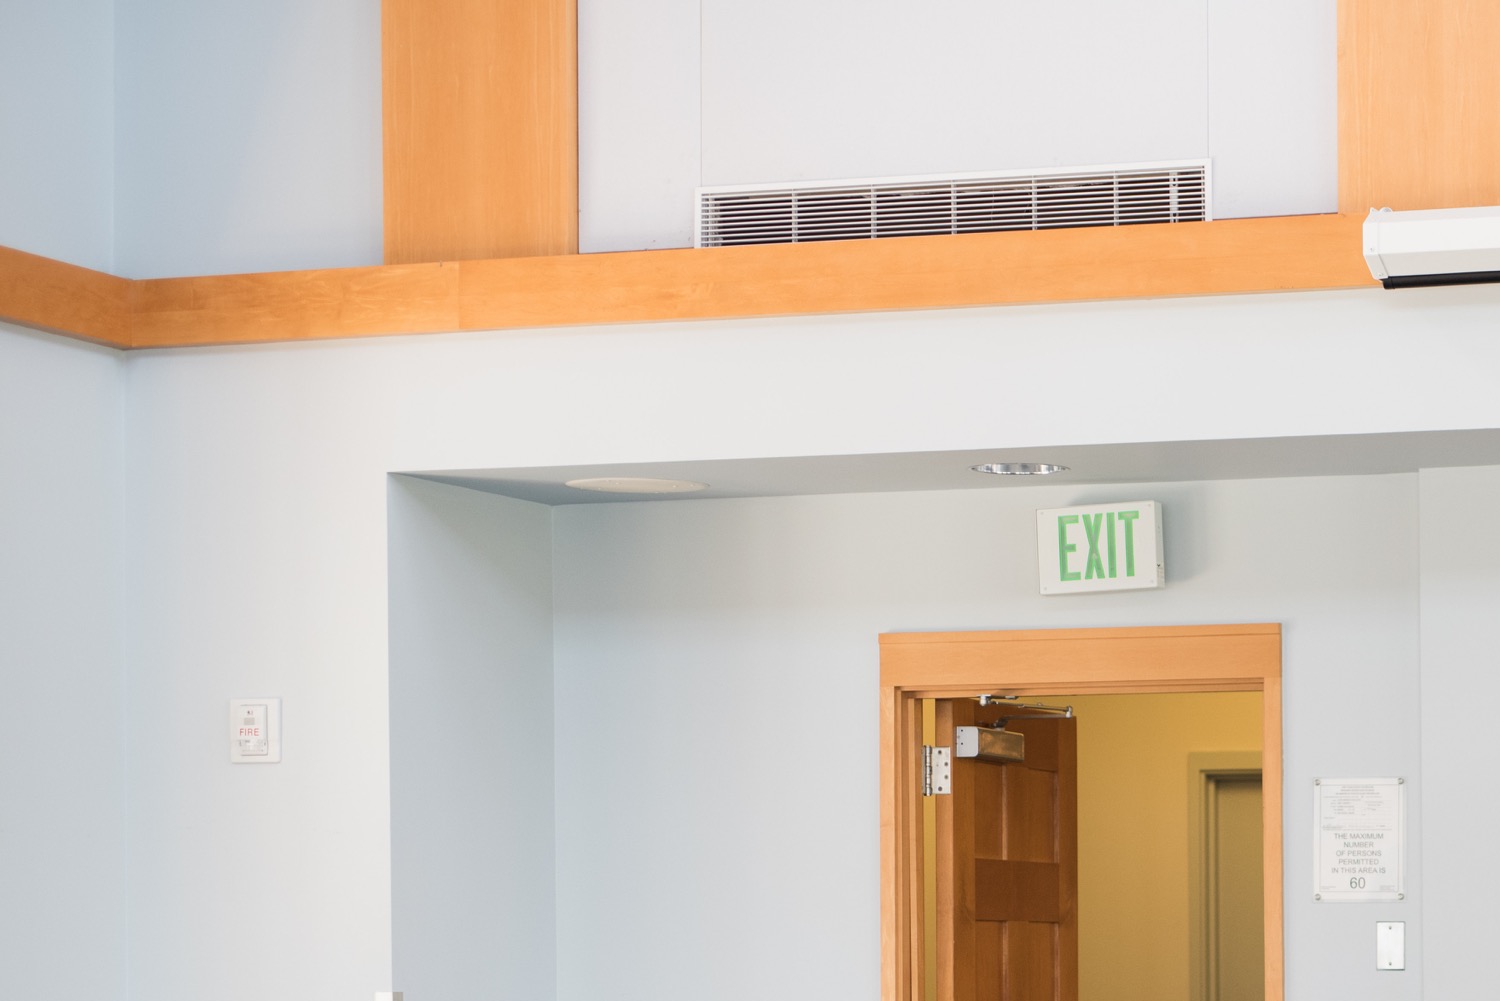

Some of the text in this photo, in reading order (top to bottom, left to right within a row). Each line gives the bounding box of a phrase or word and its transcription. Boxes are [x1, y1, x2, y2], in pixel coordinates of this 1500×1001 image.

[1058, 510, 1140, 582] EXIT
[240, 728, 260, 736] FIRE
[1350, 876, 1366, 889] 60
